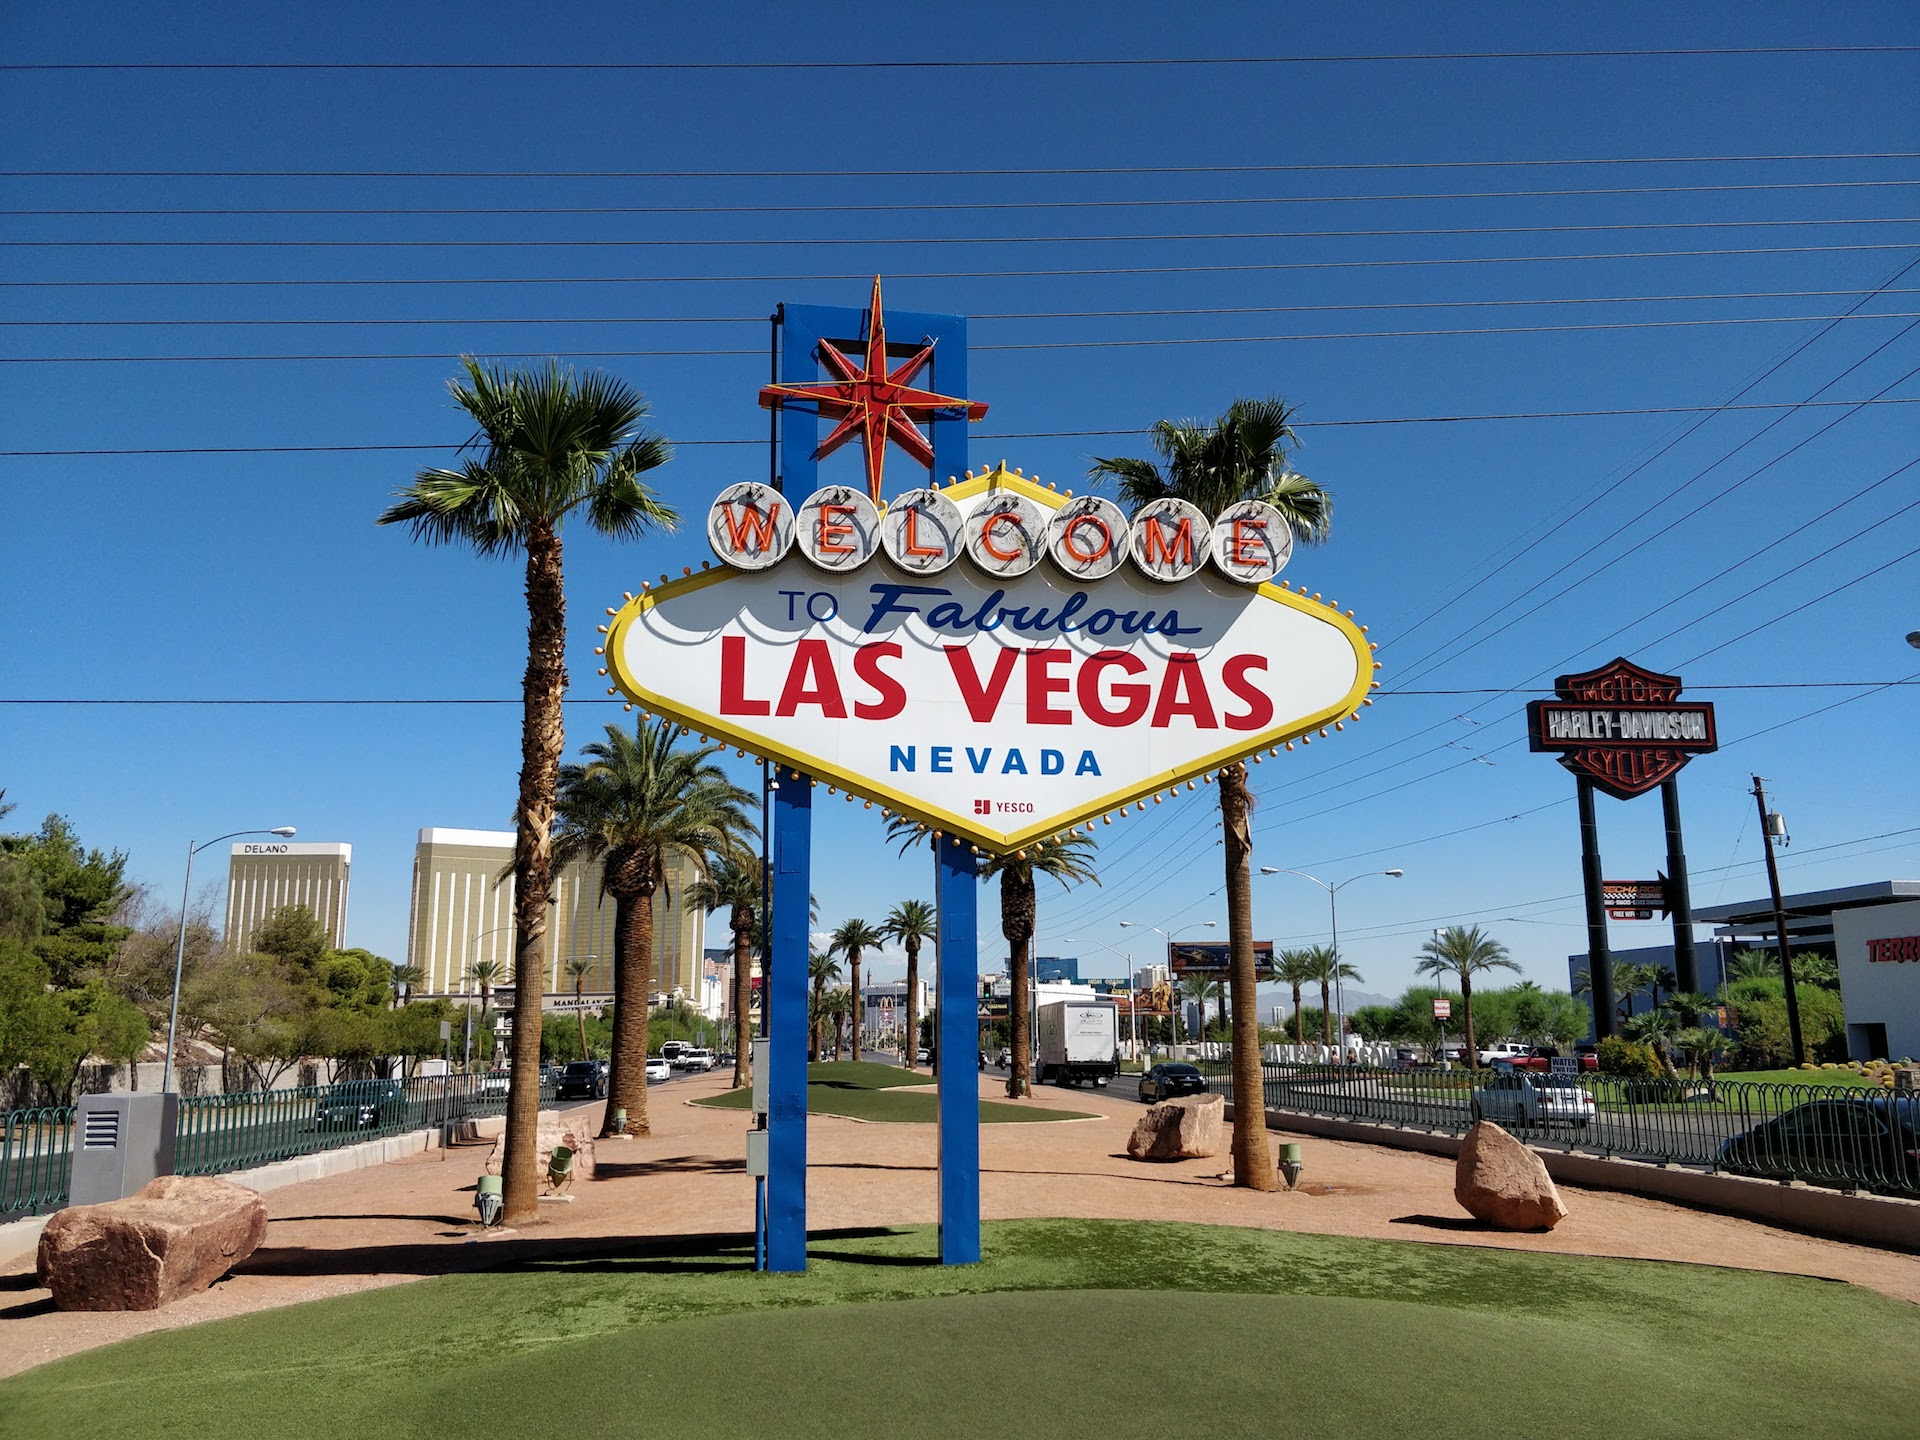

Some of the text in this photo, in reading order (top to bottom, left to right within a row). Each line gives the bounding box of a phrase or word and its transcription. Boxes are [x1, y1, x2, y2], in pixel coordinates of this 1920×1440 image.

[722, 500, 1268, 566] WELCOME
[778, 583, 1203, 636] TO Fabulous
[719, 635, 1274, 731] LAS VEGAS
[1582, 670, 1665, 702] MOTOR
[1547, 710, 1707, 740] HARLEY-DAVIDSON
[889, 745, 1102, 777] NEVADA
[1587, 750, 1670, 784] CYCLES
[244, 844, 288, 854] DELANO
[1552, 1058, 1577, 1067] WATER
